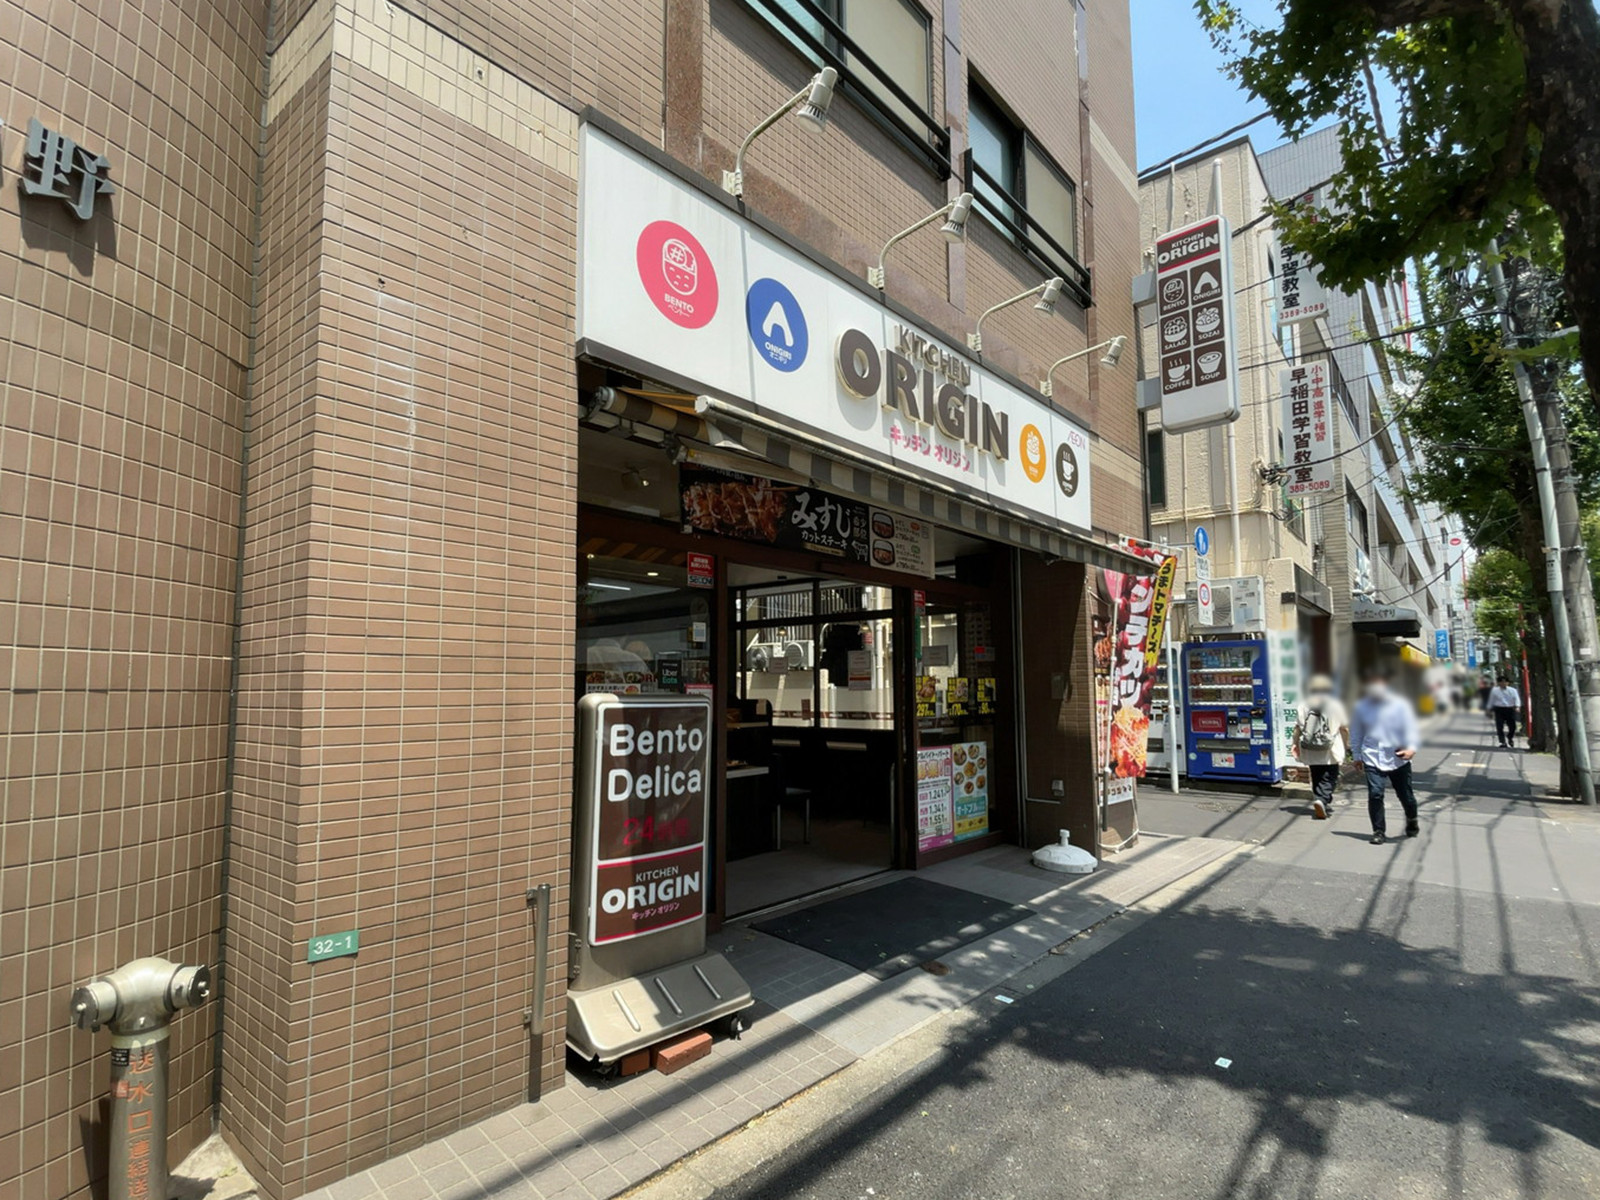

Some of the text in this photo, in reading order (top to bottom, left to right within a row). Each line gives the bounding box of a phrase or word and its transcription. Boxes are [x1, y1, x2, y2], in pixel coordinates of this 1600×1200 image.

[1158, 233, 1219, 265] ORIGIN
[1171, 231, 1204, 249] KITCHEN
[664, 293, 694, 314] BENTO
[1192, 287, 1221, 301] ONIGIRI
[1163, 299, 1186, 311] BENTO
[1164, 339, 1188, 350] SALAD
[1198, 329, 1220, 341] SOZAI
[764, 341, 792, 360] ONIGIRI
[894, 324, 971, 387] KITCHEN
[1164, 379, 1191, 391] COFFEE
[1200, 371, 1221, 381] SOUP
[836, 328, 1009, 462] ORIGIN
[1290, 367, 1313, 484] 早稲田学習教室
[889, 425, 971, 473] キッチン オリジン
[791, 491, 851, 538] みすじ
[801, 530, 848, 549] カットステーキ
[662, 669, 678, 677] Uber
[662, 676, 678, 684] Eats
[610, 723, 703, 757] Bento
[608, 765, 702, 802] Delica
[635, 866, 679, 882] KITCHEN
[601, 871, 700, 914] ORIGIN
[631, 901, 680, 920] キッチン オリジン
[313, 936, 352, 956] 32-1
[127, 1048, 155, 1134] 送水口
[127, 1139, 151, 1200] 連結送
